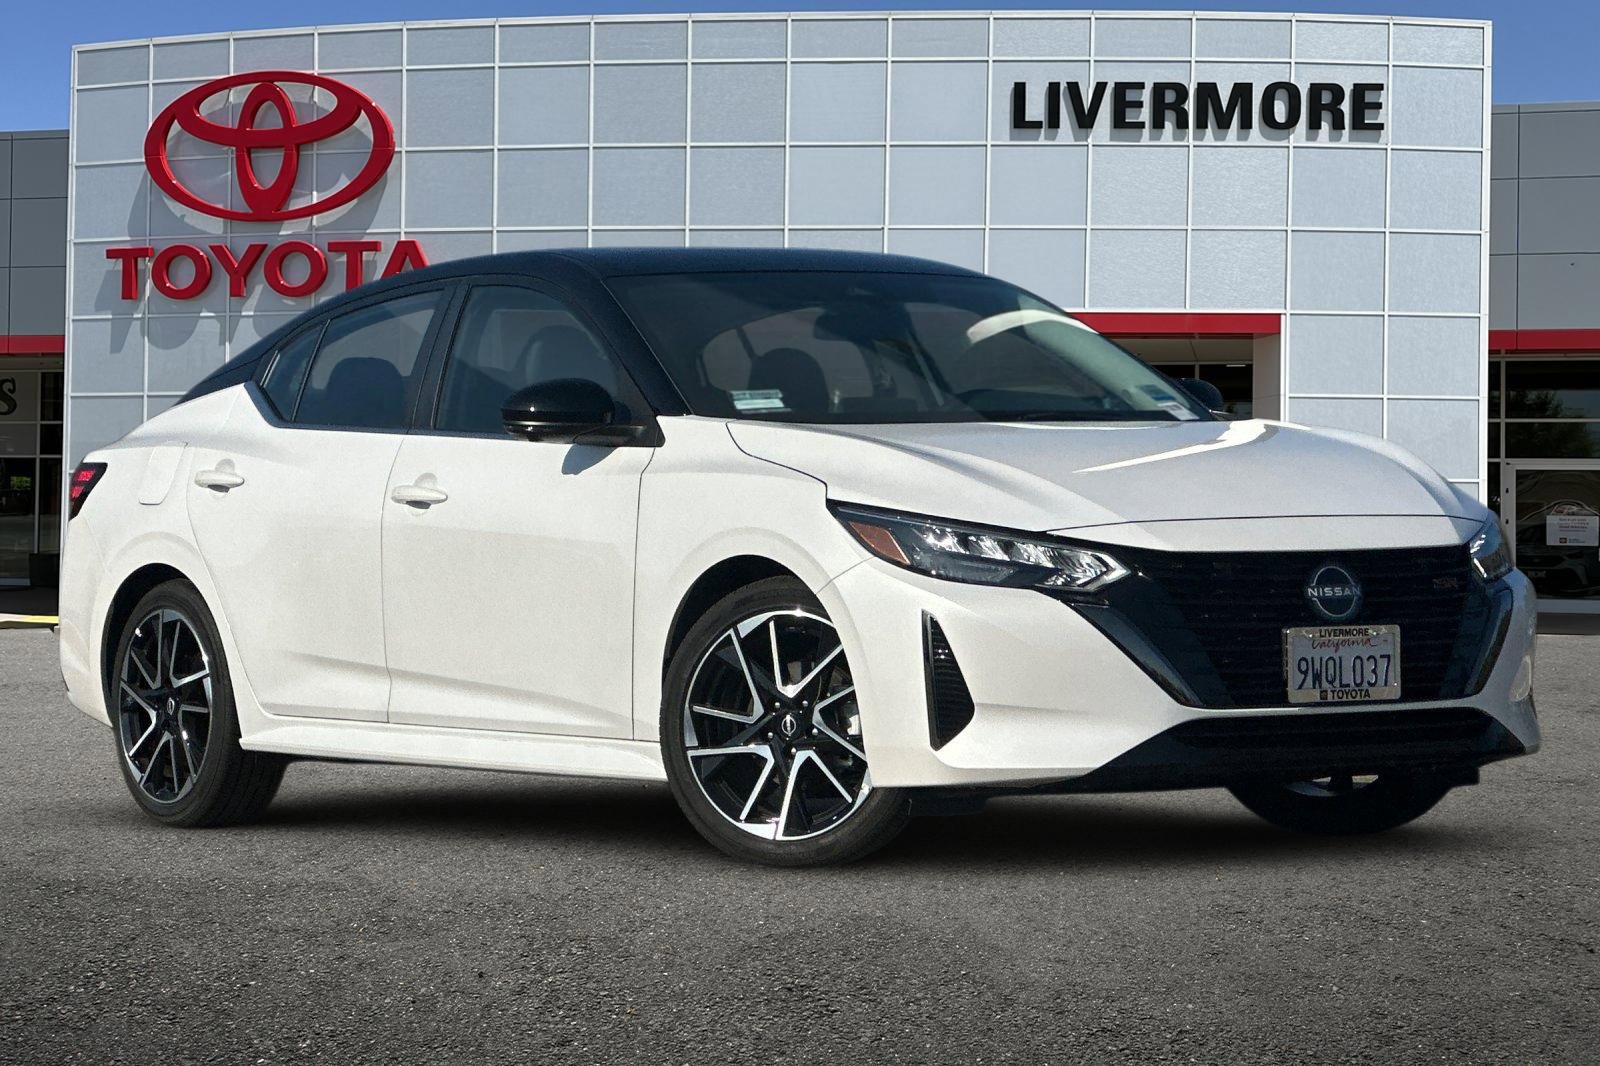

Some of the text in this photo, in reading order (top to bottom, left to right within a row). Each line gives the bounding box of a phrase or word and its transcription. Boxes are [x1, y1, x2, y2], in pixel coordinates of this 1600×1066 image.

[1012, 80, 1385, 132] LIVERMORE
[1307, 585, 1361, 597] NISSAN
[1319, 627, 1370, 638] LIVERMORE
[1296, 654, 1391, 690] 9WQL037
[1331, 688, 1371, 699] TOYOTA
